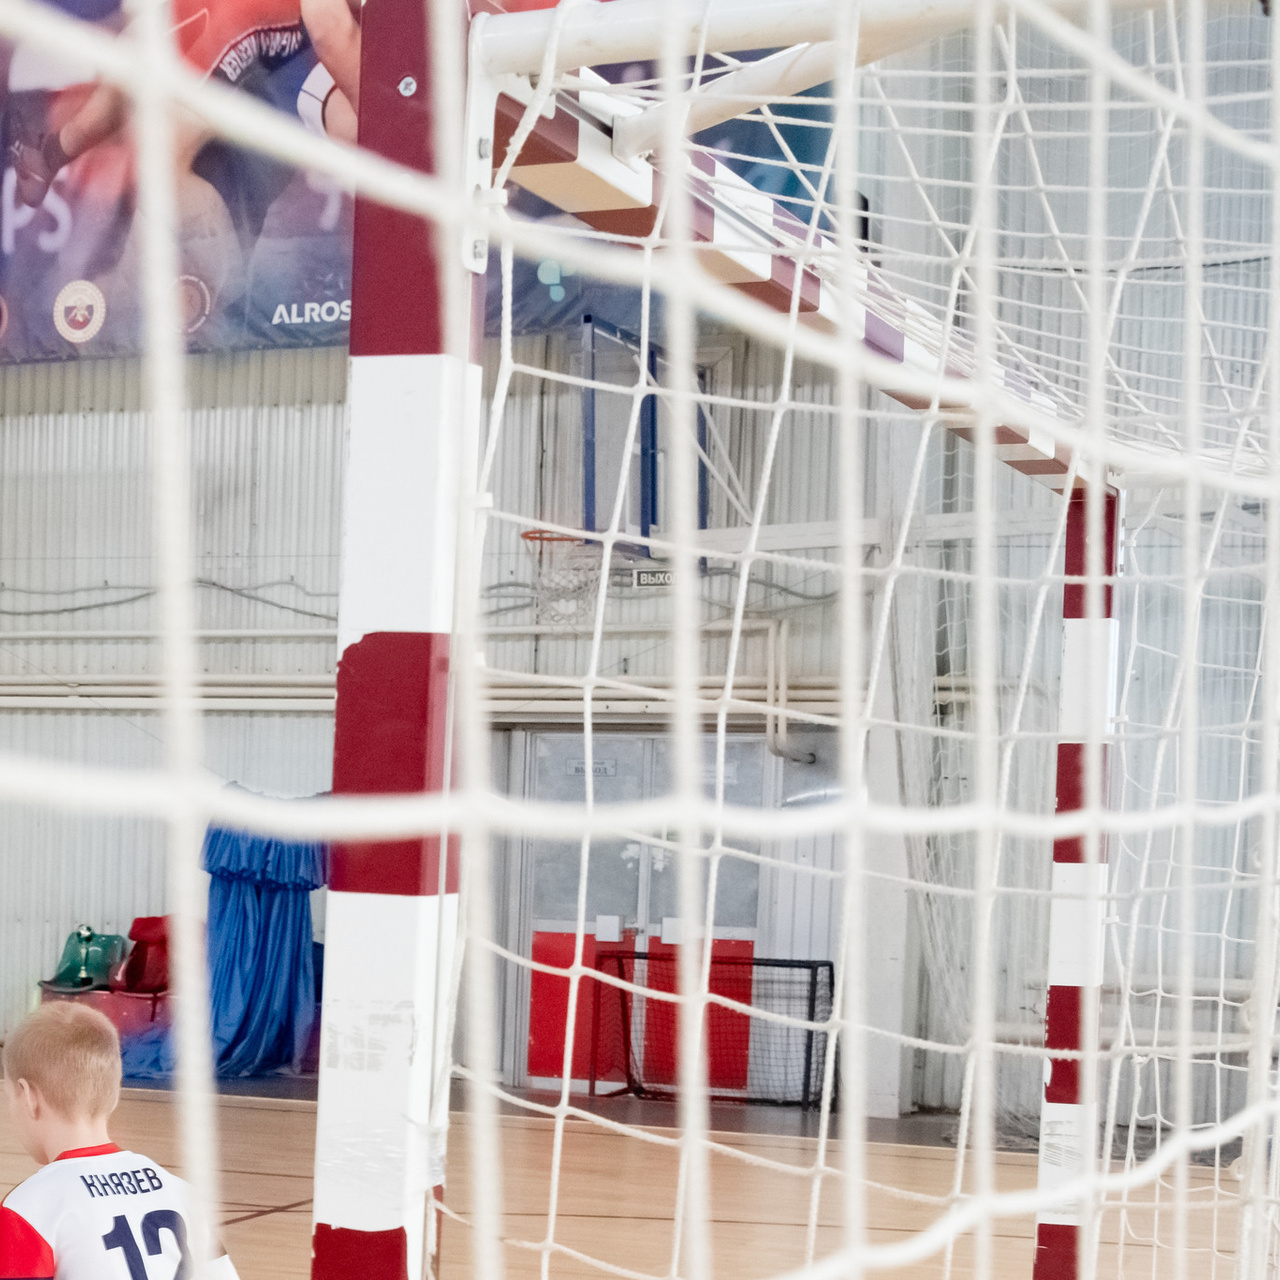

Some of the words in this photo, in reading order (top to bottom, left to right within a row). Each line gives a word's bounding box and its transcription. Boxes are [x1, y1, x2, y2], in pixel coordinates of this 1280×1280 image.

[272, 300, 351, 325] ALROS
[640, 572, 676, 586] ВЫХО
[80, 1167, 163, 1198] КНЯЗЕВ
